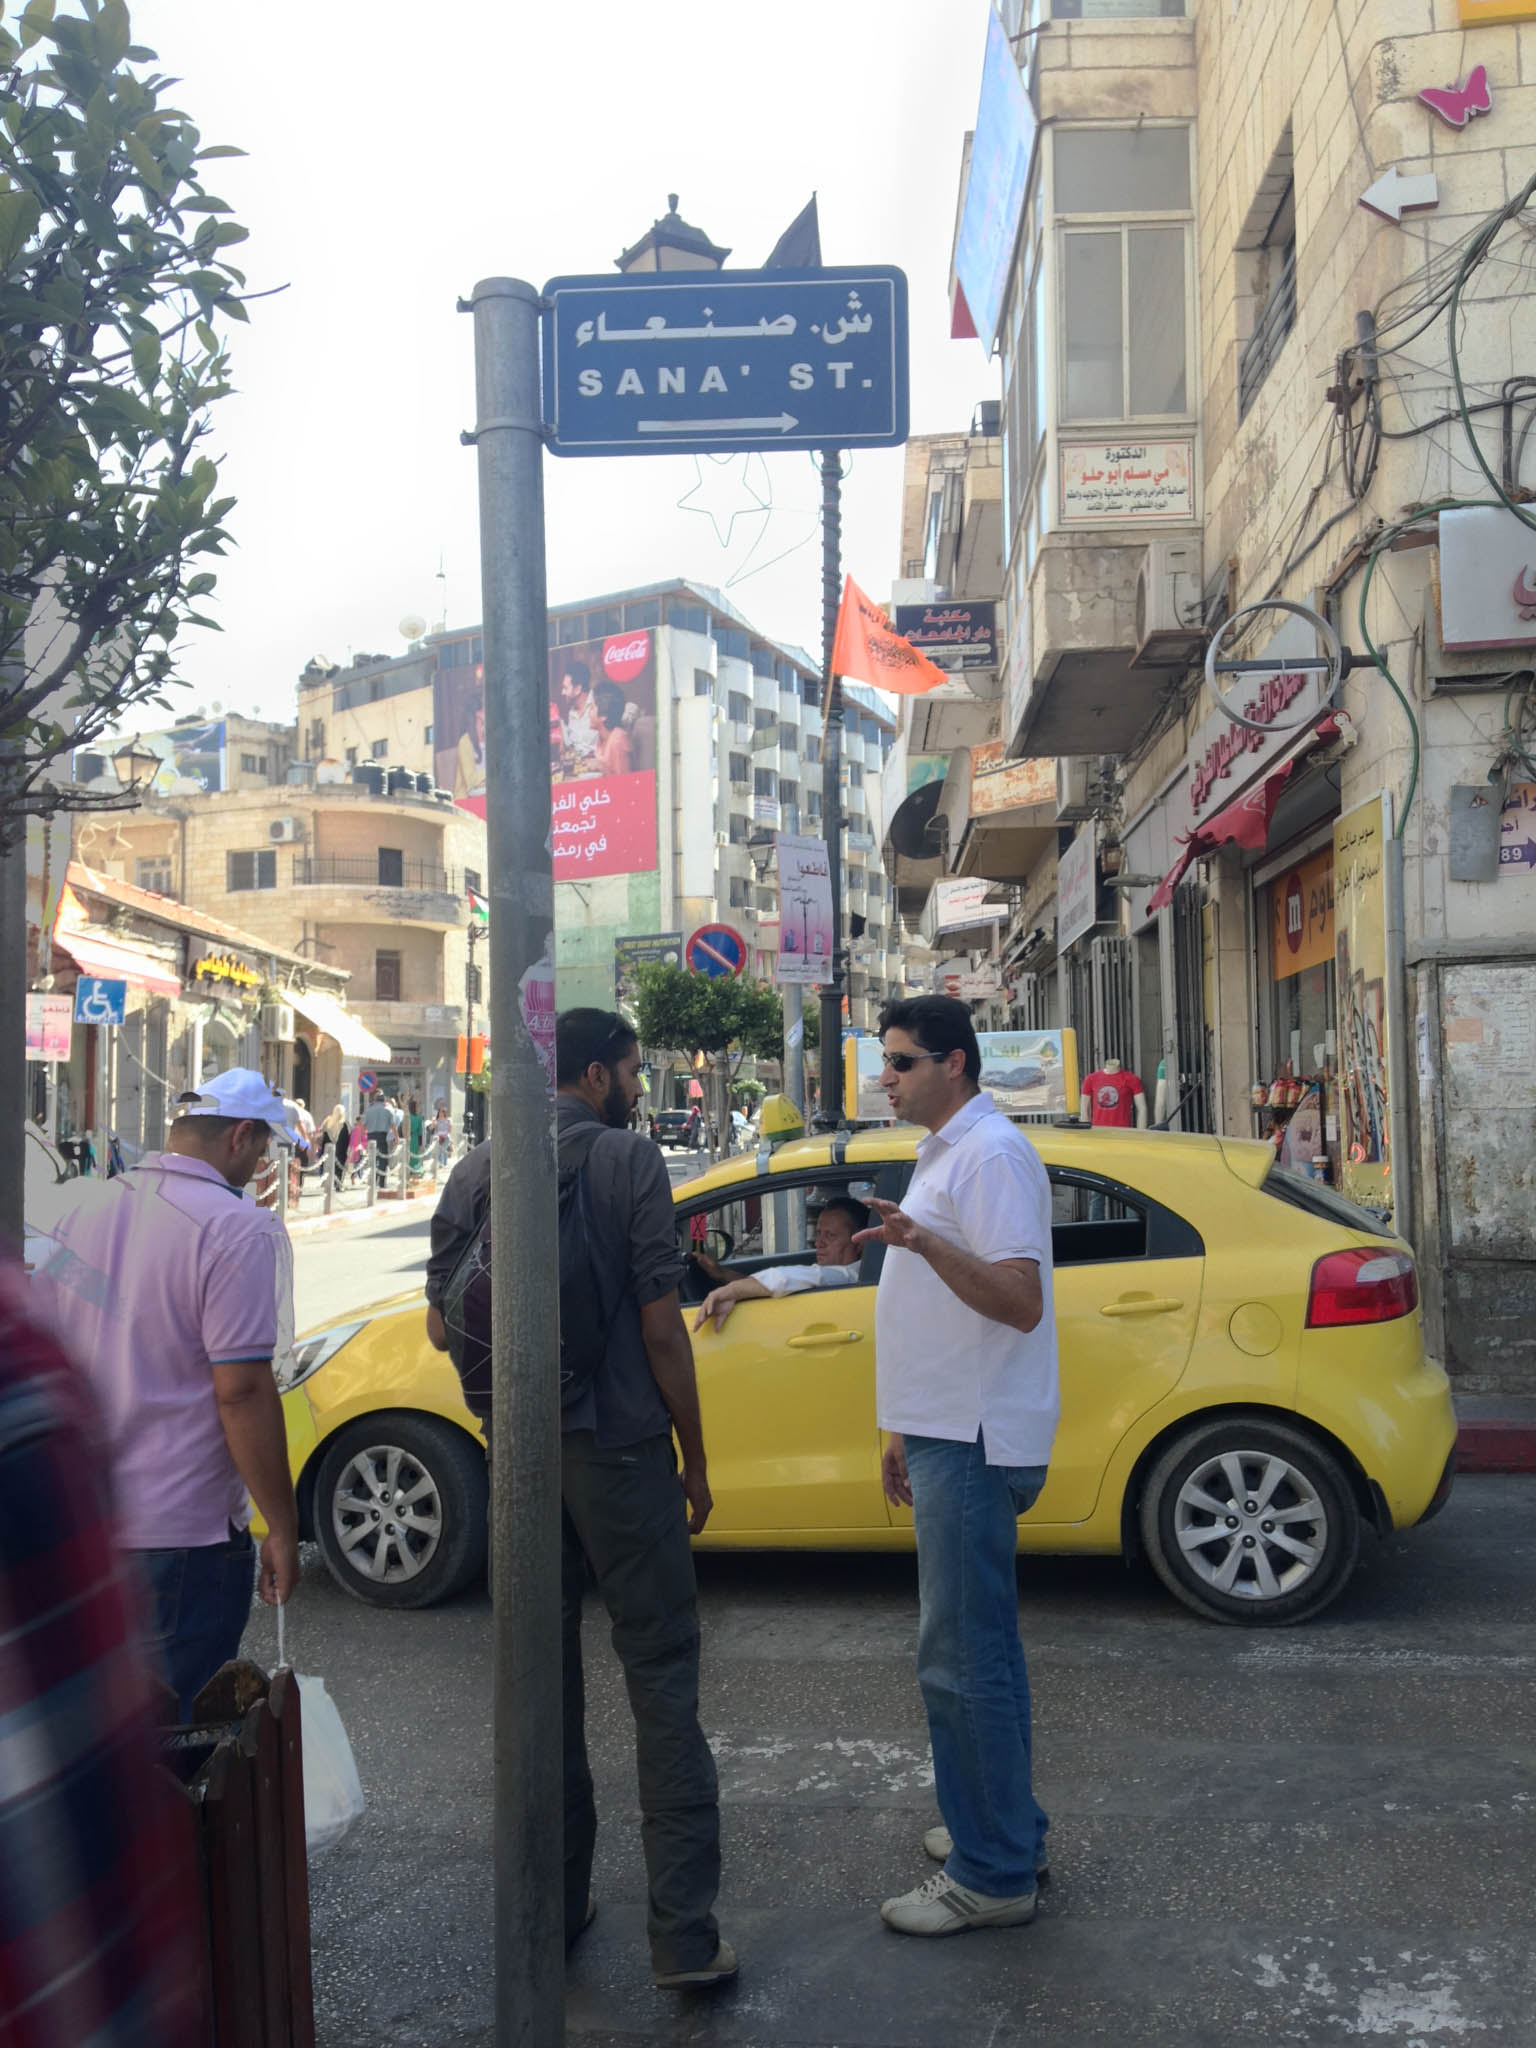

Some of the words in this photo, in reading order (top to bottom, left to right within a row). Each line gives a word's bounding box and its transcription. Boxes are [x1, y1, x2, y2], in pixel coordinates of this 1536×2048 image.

[575, 307, 797, 347] صنعاء
[787, 361, 873, 392] ST.
[1105, 446, 1146, 463] الدكتورة
[923, 608, 971, 626] مكتبة
[552, 793, 576, 815] الفر
[579, 789, 611, 815] خلي
[553, 815, 597, 835] تجمعن
[553, 843, 582, 859] رمض
[584, 834, 607, 861] في
